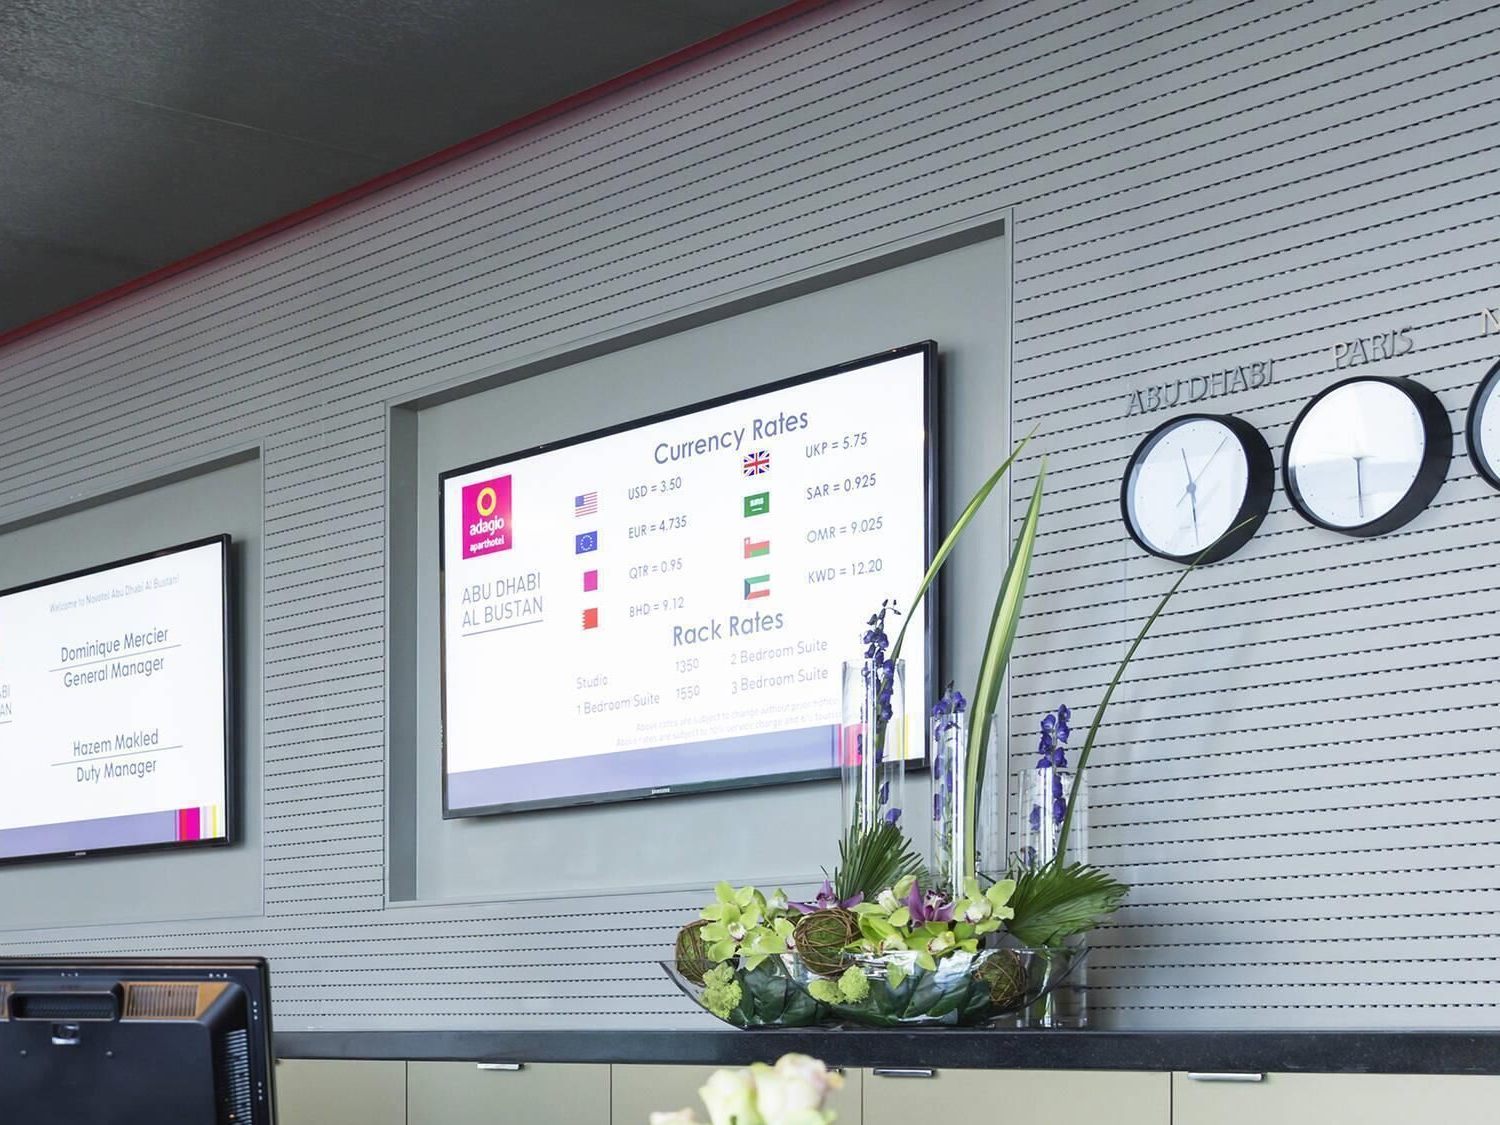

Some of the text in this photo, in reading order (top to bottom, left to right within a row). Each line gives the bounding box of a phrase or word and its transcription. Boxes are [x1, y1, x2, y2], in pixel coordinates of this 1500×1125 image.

[1331, 326, 1414, 369] PARIS
[1126, 359, 1273, 417] ABU DHABI
[654, 411, 808, 464] Currency Rates
[805, 441, 828, 458] UKP
[843, 431, 868, 449] 5.75
[628, 484, 647, 500] USD
[660, 477, 682, 493] 3.50
[806, 482, 829, 500] SAR
[844, 473, 876, 492] 0.925
[469, 515, 505, 536] adagio
[628, 524, 647, 539] EUR
[659, 515, 687, 532] 4.735
[807, 526, 836, 544] OMR
[851, 516, 883, 535] 9.025
[469, 536, 505, 553] aparthotel
[629, 564, 649, 580] QTR
[661, 558, 682, 572] 0.95
[808, 566, 835, 584] KWD
[851, 558, 883, 577] 12.20
[462, 572, 541, 604] ABU DHABI
[462, 596, 543, 628] AL BUSTAN
[629, 603, 650, 618] BHD
[662, 596, 684, 612] 9.12
[673, 611, 784, 647] Rack Rates
[61, 627, 169, 663] Dominique Mercier
[730, 638, 828, 665] 2 Bedroom Suite
[63, 657, 164, 688] General Manager
[576, 674, 608, 690] Studio
[731, 666, 829, 695] 3 Bedroom Suite
[584, 696, 630, 714] Bedroom
[633, 692, 660, 708] Suite
[73, 728, 159, 757] Hazem Makled
[76, 760, 157, 784] Duty Manager
